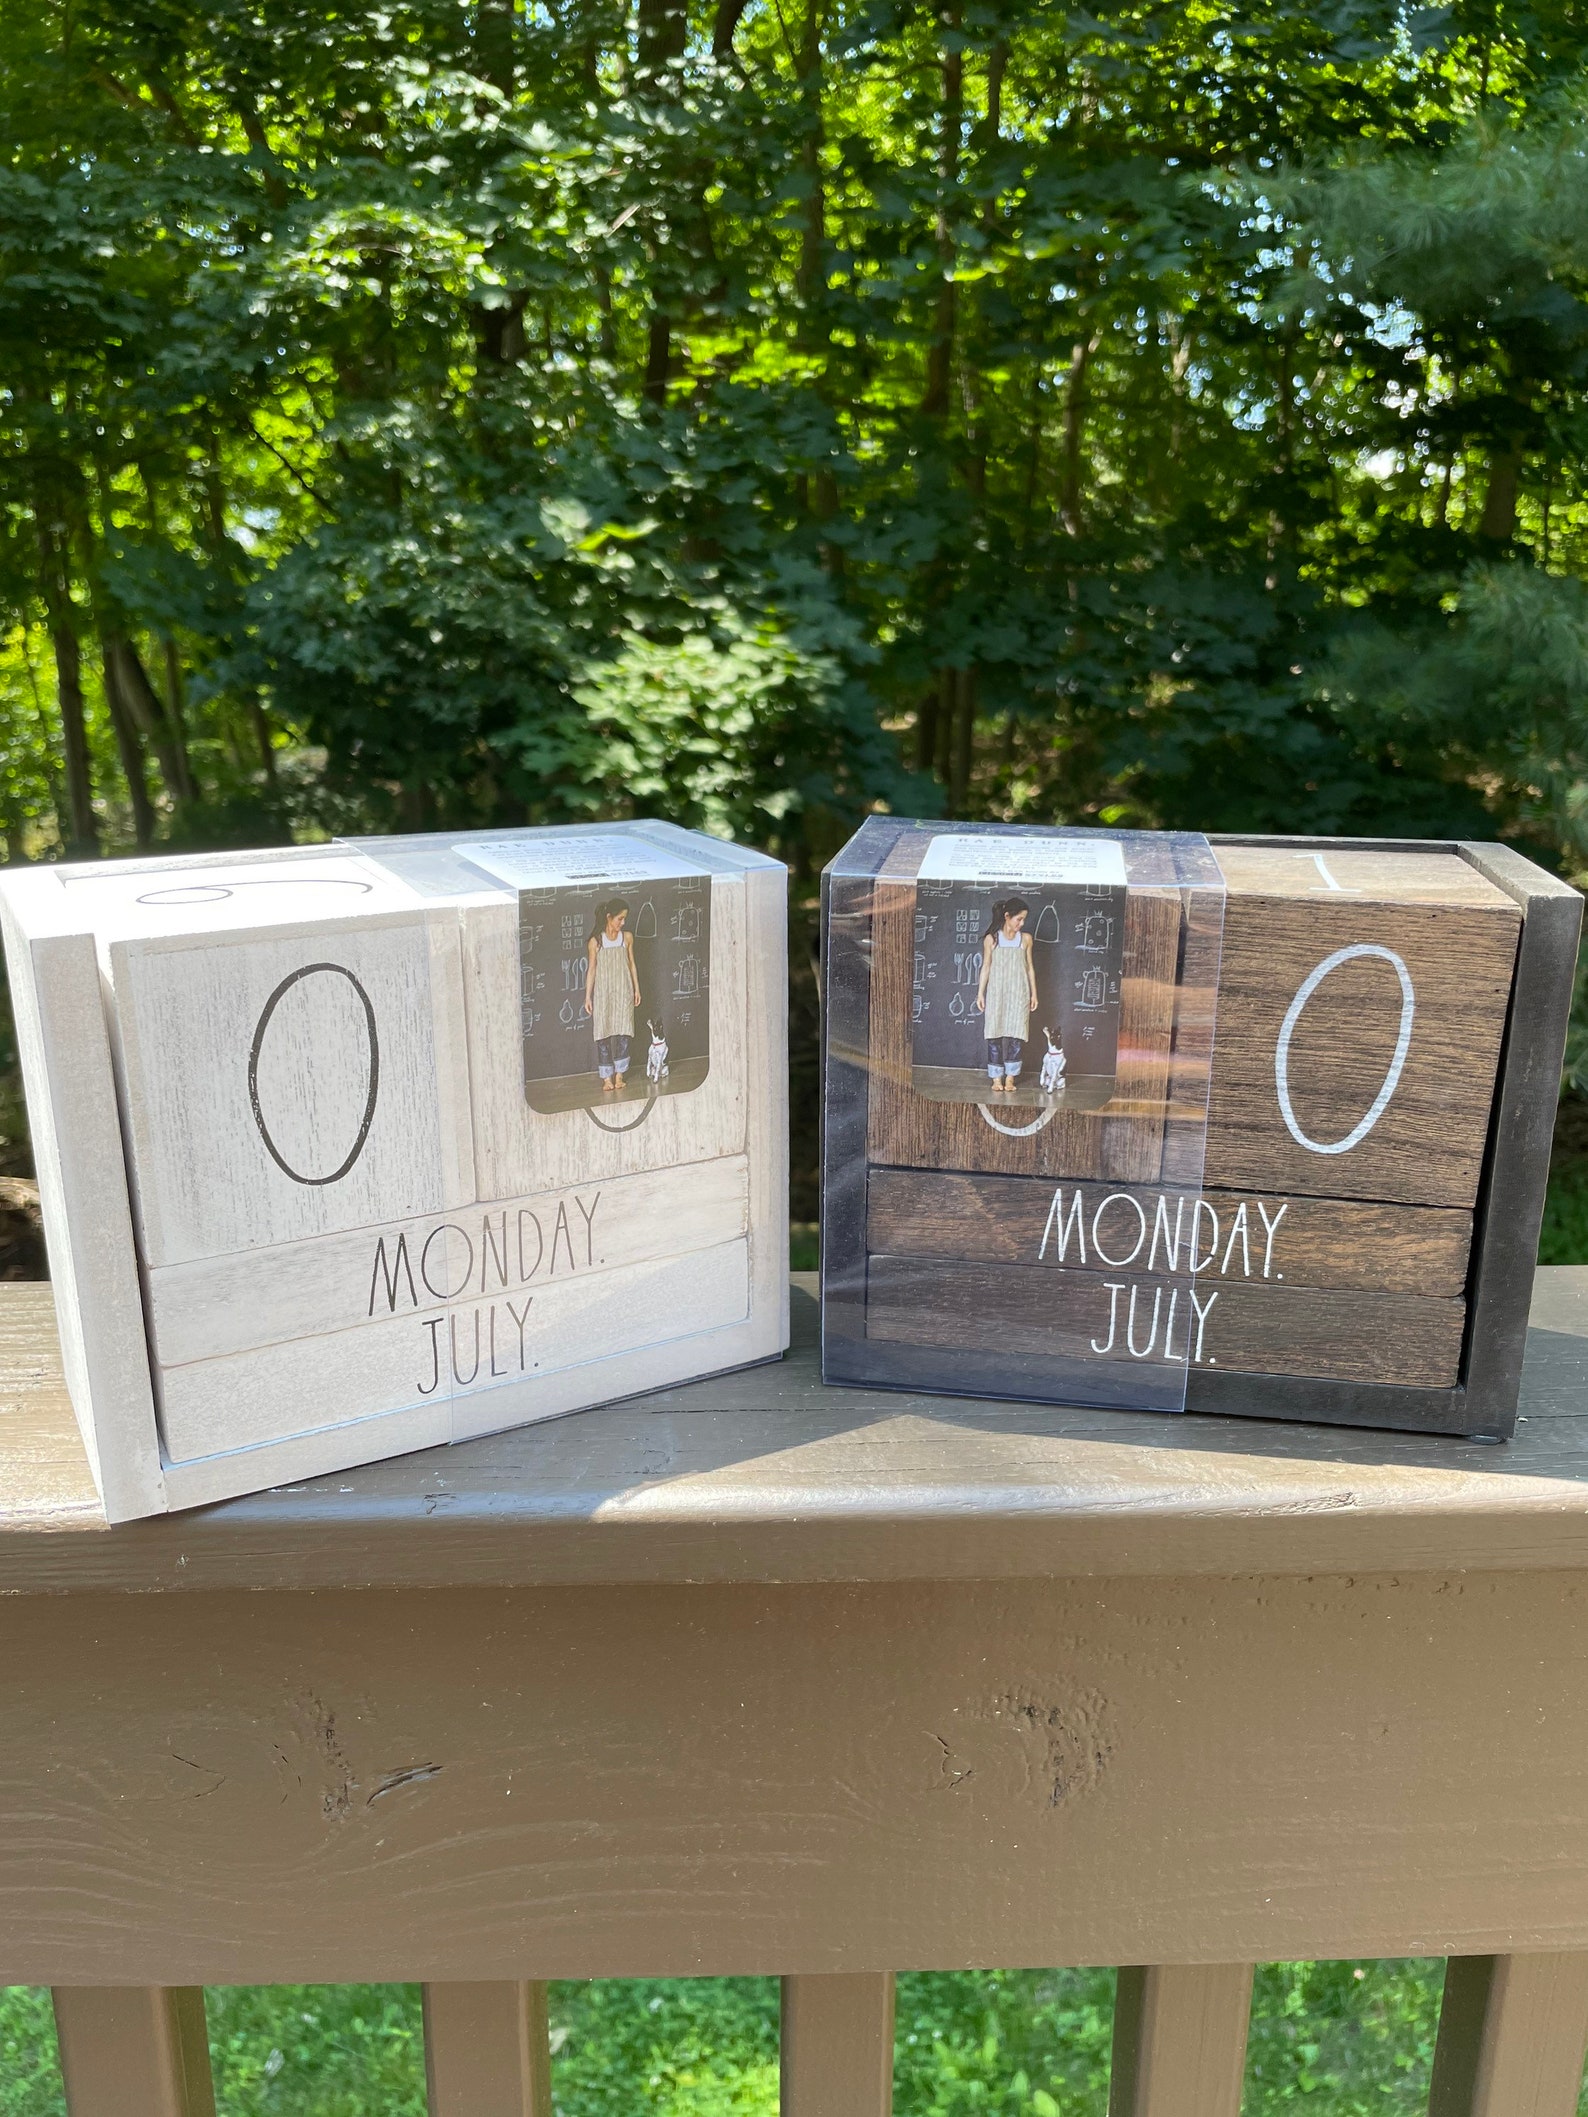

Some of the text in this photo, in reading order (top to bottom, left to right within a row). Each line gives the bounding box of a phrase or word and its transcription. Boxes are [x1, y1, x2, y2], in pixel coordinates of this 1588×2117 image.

[249, 962, 380, 1186] 0
[1275, 943, 1415, 1156] 0
[368, 1191, 606, 1316] MONDAY.
[1038, 1188, 1288, 1281] MONDAY.
[416, 1297, 540, 1396] JULY.
[1091, 1282, 1220, 1364] JULY.
